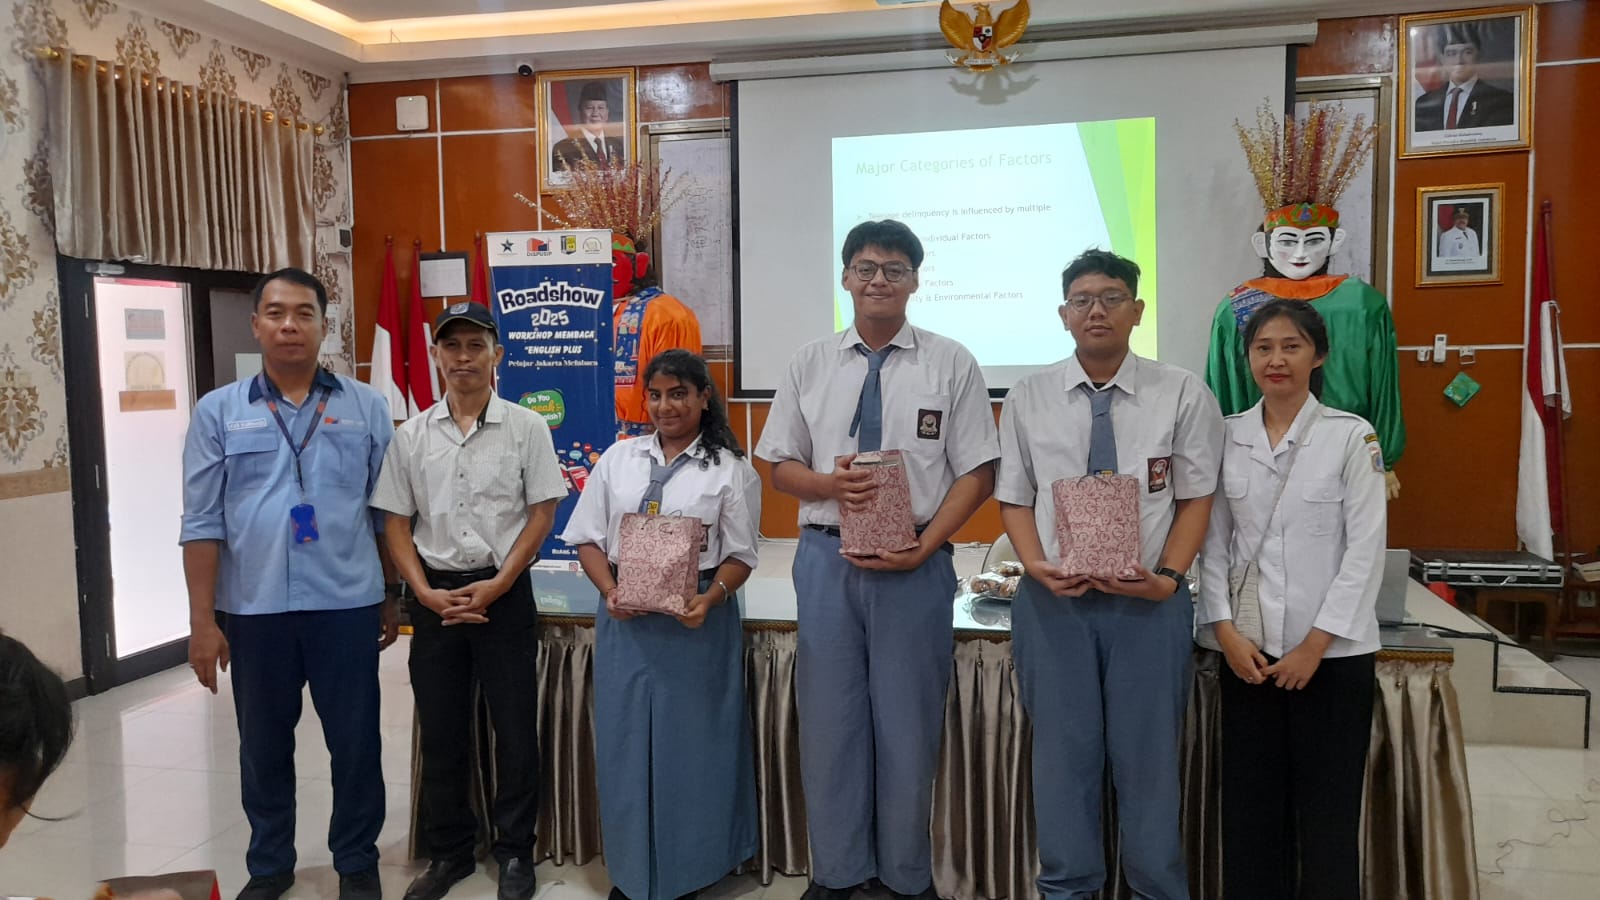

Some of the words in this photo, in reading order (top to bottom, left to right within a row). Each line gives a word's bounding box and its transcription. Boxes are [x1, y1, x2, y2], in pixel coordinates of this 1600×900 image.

[856, 160, 895, 176] Major
[900, 156, 975, 173] Categories
[979, 154, 993, 168] of
[1000, 153, 1052, 166] Factors
[902, 208, 949, 219] delinquency
[961, 206, 1003, 215] influenced
[1005, 205, 1015, 214] by
[1017, 203, 1052, 213] multiple
[921, 233, 959, 242] ndividual
[961, 232, 992, 240] Factors
[925, 279, 954, 287] Factors
[499, 283, 602, 312] Roadshow
[934, 292, 992, 302] Environmental
[993, 291, 1024, 299] Factors
[531, 309, 570, 327] 2025
[508, 331, 553, 340] WORKSHOP
[554, 330, 595, 339] MEMBACA
[562, 345, 583, 354] PLUS
[535, 359, 562, 367] Jakarta
[537, 394, 550, 402] You
